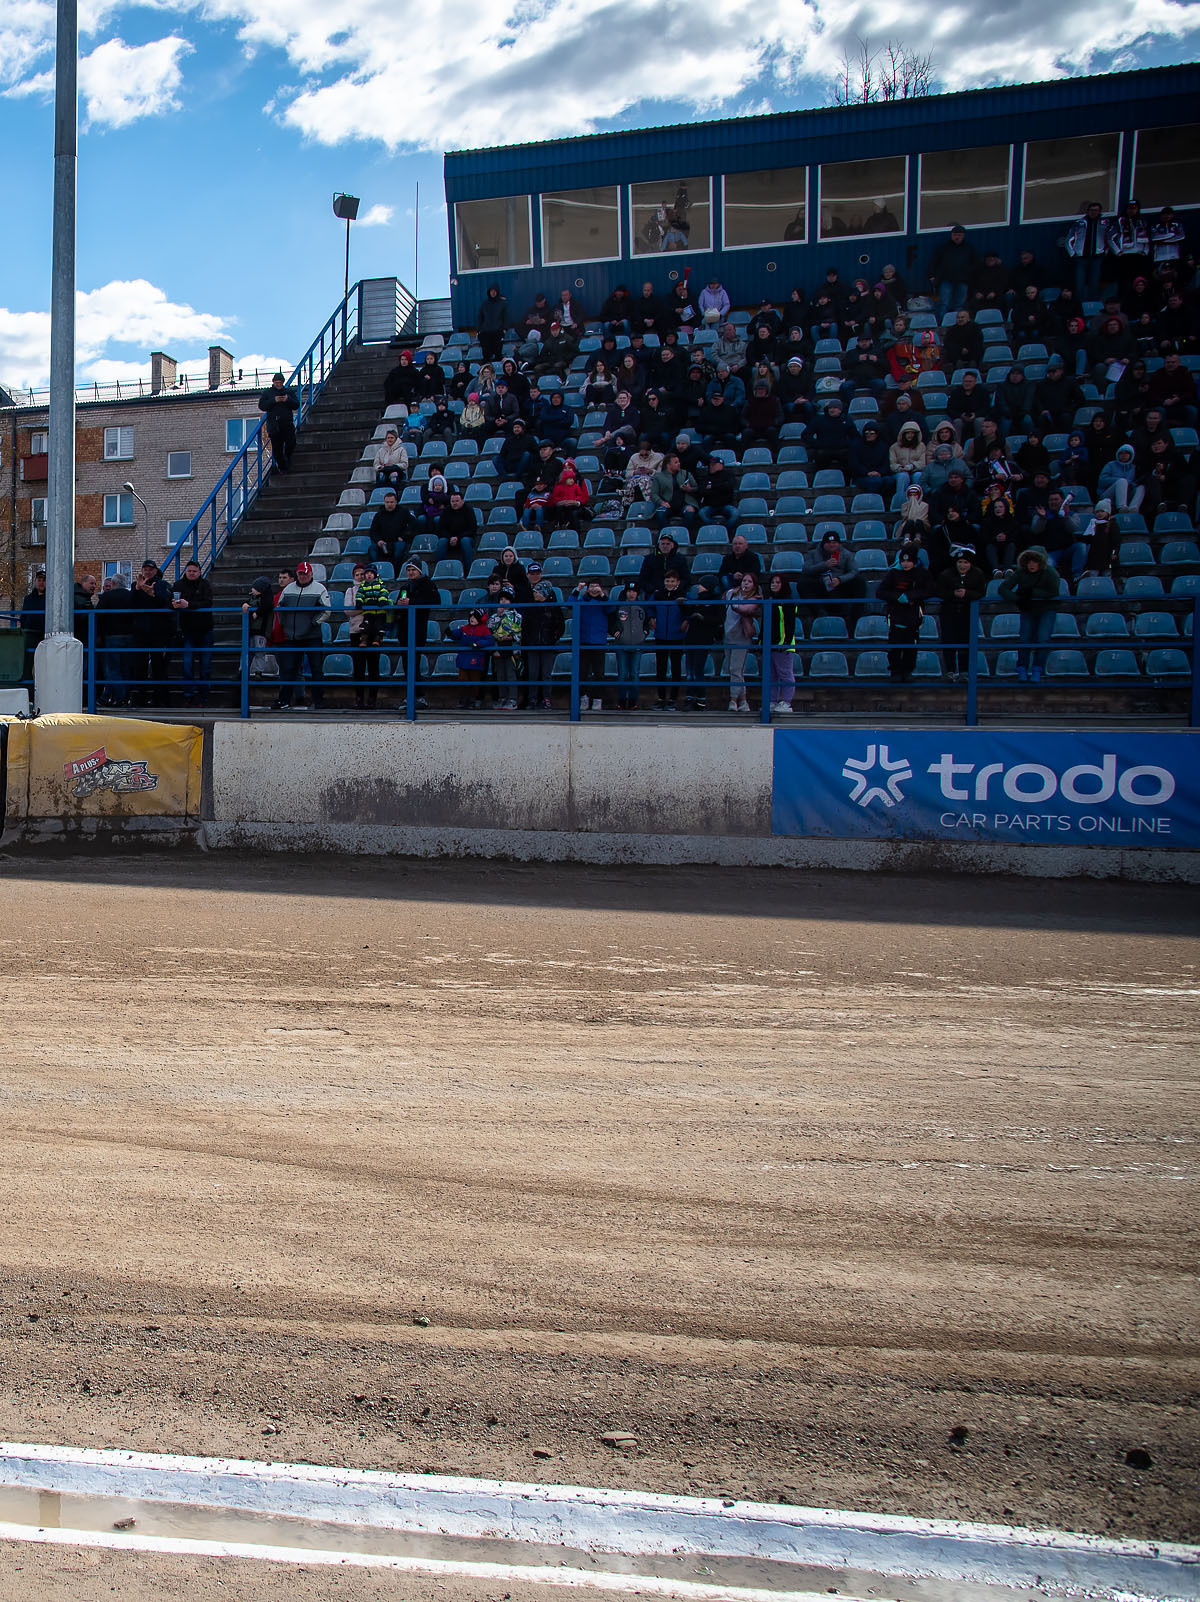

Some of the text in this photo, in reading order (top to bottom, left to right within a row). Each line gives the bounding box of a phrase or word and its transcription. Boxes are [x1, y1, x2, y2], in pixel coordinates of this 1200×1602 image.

[72, 757, 100, 774] A PLUS+
[927, 753, 1176, 805] trodo
[940, 812, 1172, 834] CAR PARTS ONLINE
